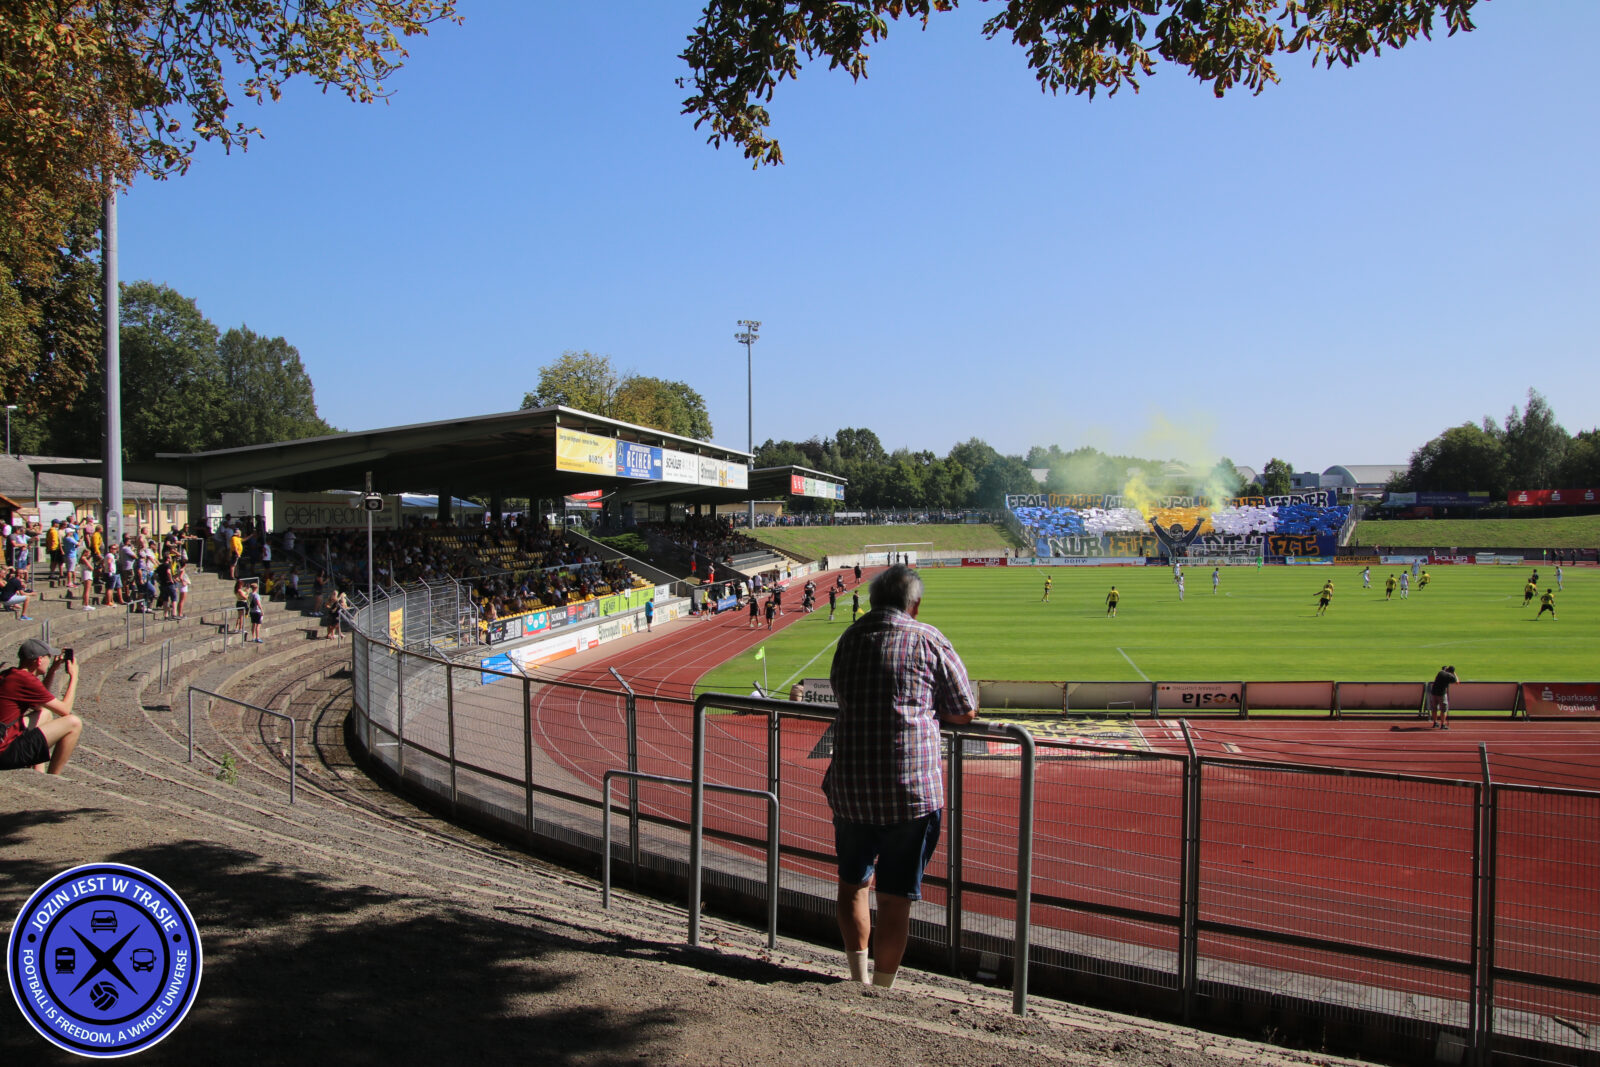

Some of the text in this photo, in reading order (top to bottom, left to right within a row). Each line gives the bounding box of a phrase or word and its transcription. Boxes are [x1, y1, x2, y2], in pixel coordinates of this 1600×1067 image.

[627, 450, 652, 470] REIHER
[1047, 536, 1104, 557] NUR
[1555, 693, 1599, 702] Sparkasse
[1557, 703, 1596, 712] Vogtland
